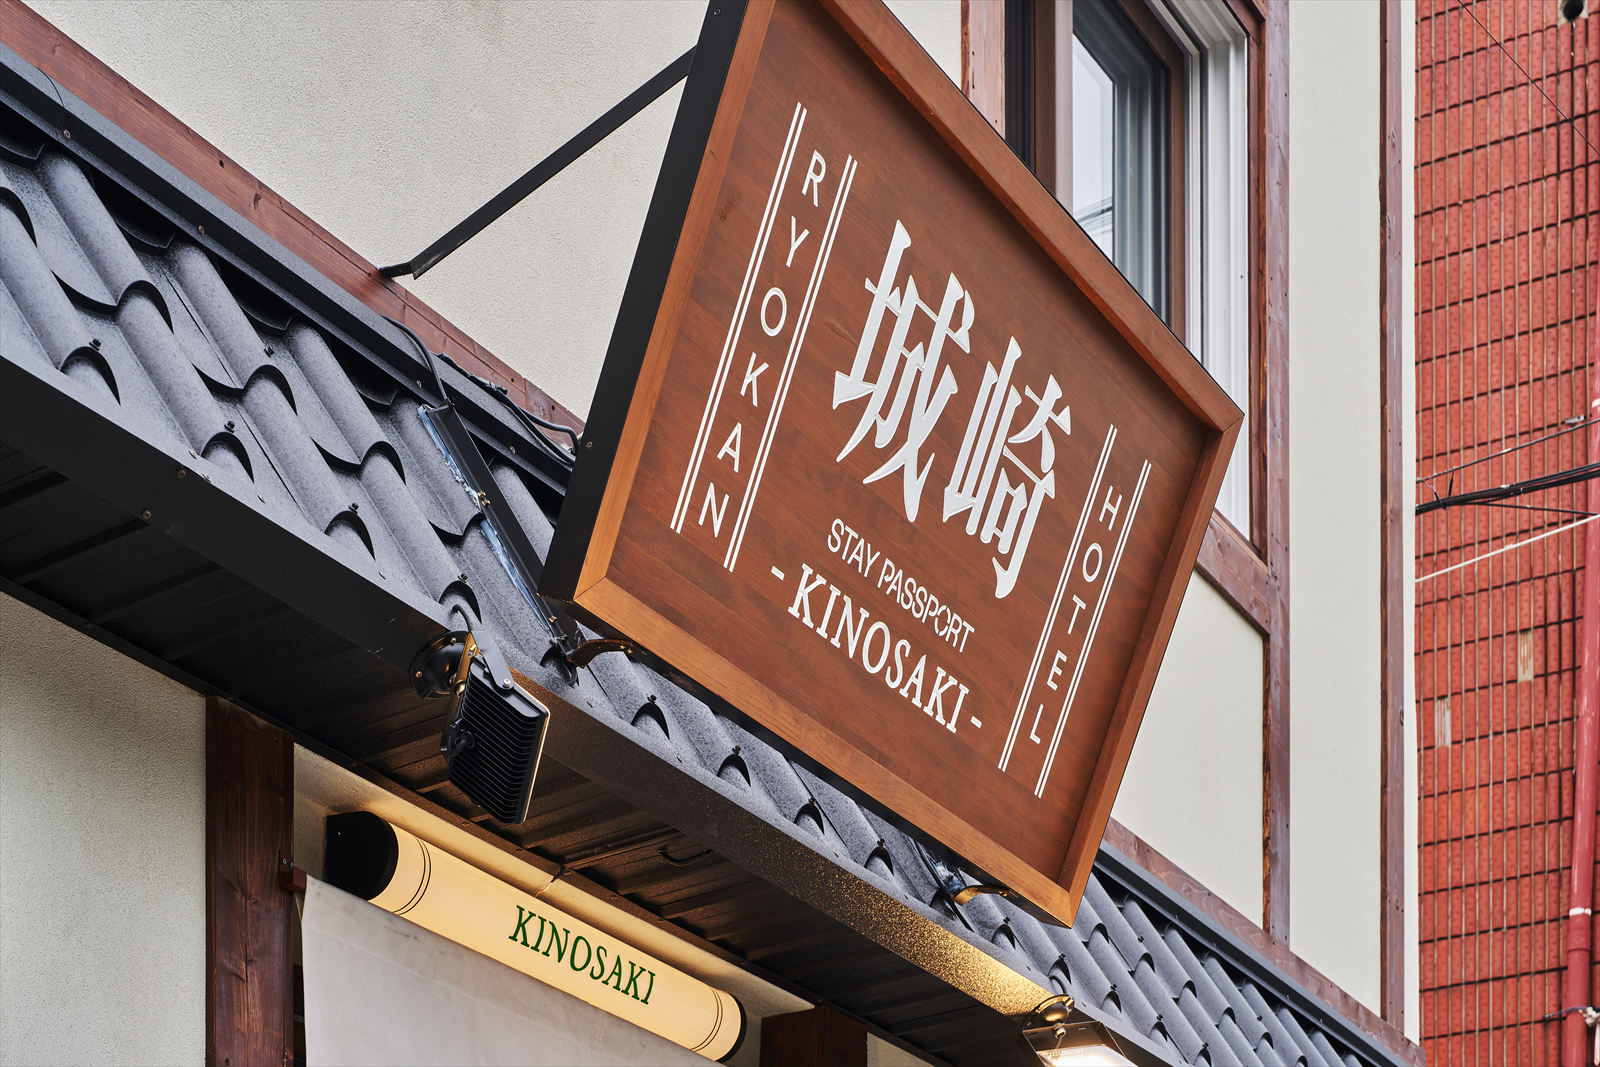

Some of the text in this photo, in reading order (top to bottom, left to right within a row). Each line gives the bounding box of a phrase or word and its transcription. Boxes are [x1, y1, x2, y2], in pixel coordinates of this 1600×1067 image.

[697, 149, 828, 539] RYOKAN
[832, 219, 1072, 600] 城崎
[827, 518, 976, 654] STAY PASSPORT
[1029, 484, 1123, 745] HOTEL
[508, 904, 656, 1005] KINOSAKI
